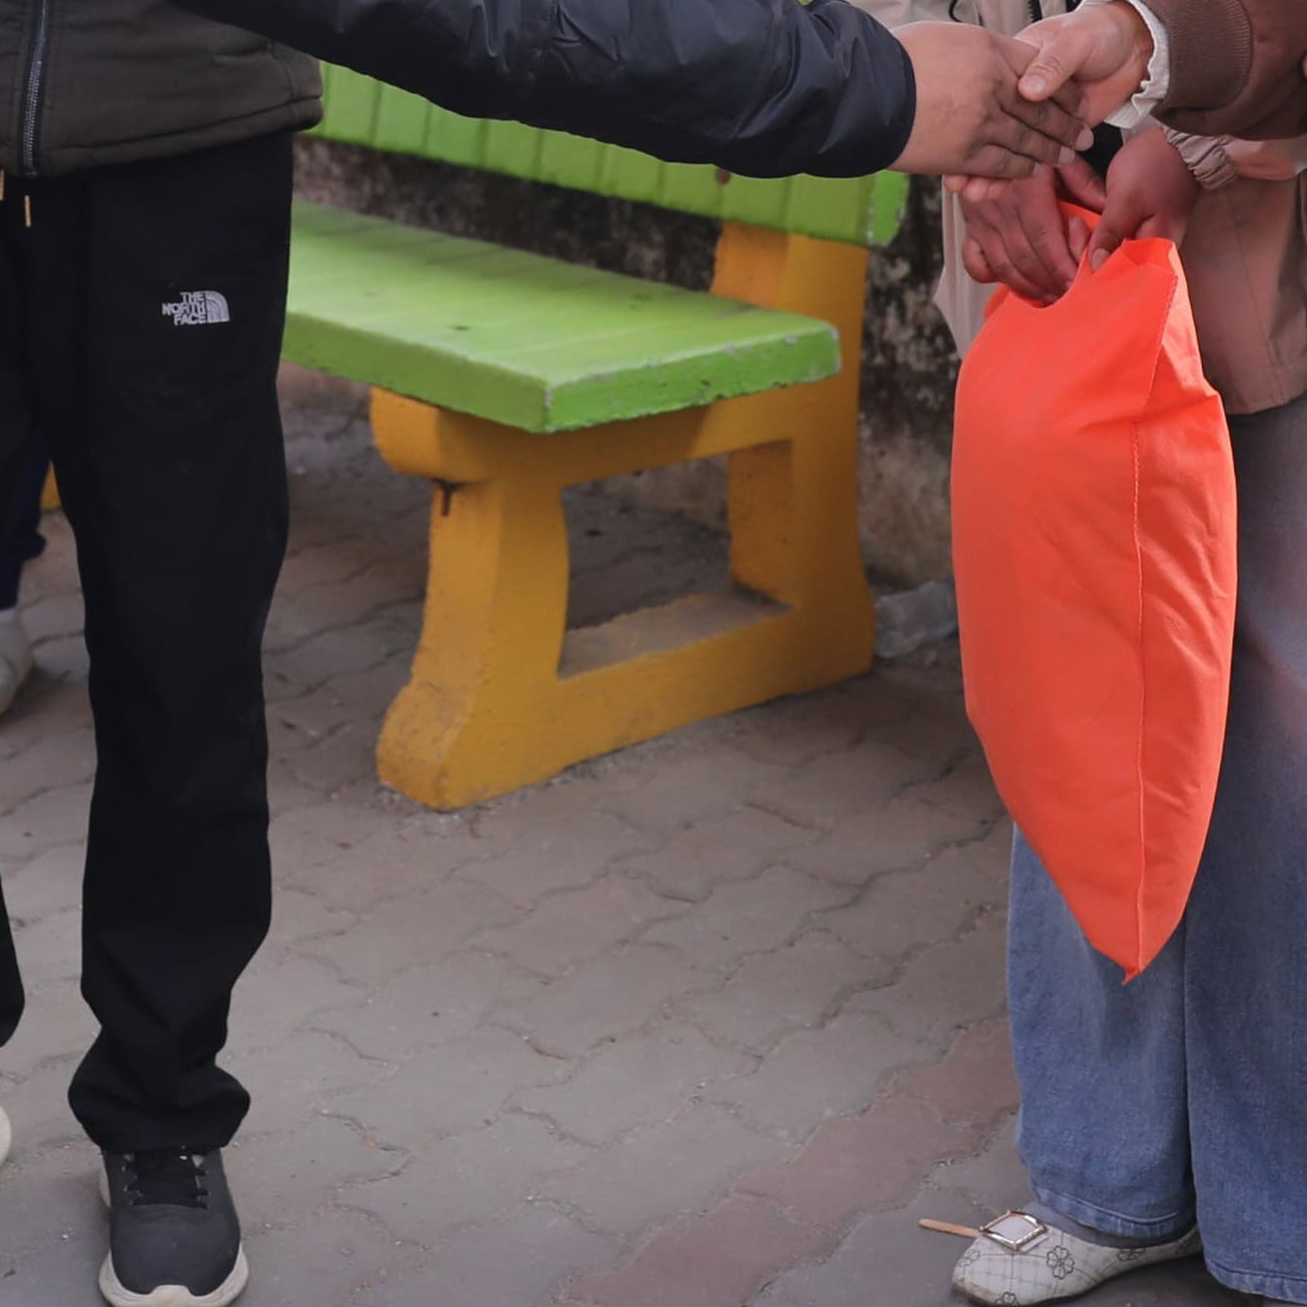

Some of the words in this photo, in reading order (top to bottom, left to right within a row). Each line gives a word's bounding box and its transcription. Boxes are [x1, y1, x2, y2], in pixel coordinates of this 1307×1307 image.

[180, 292, 204, 304] THE
[161, 301, 205, 316] NORTH
[174, 313, 206, 326] FACE
